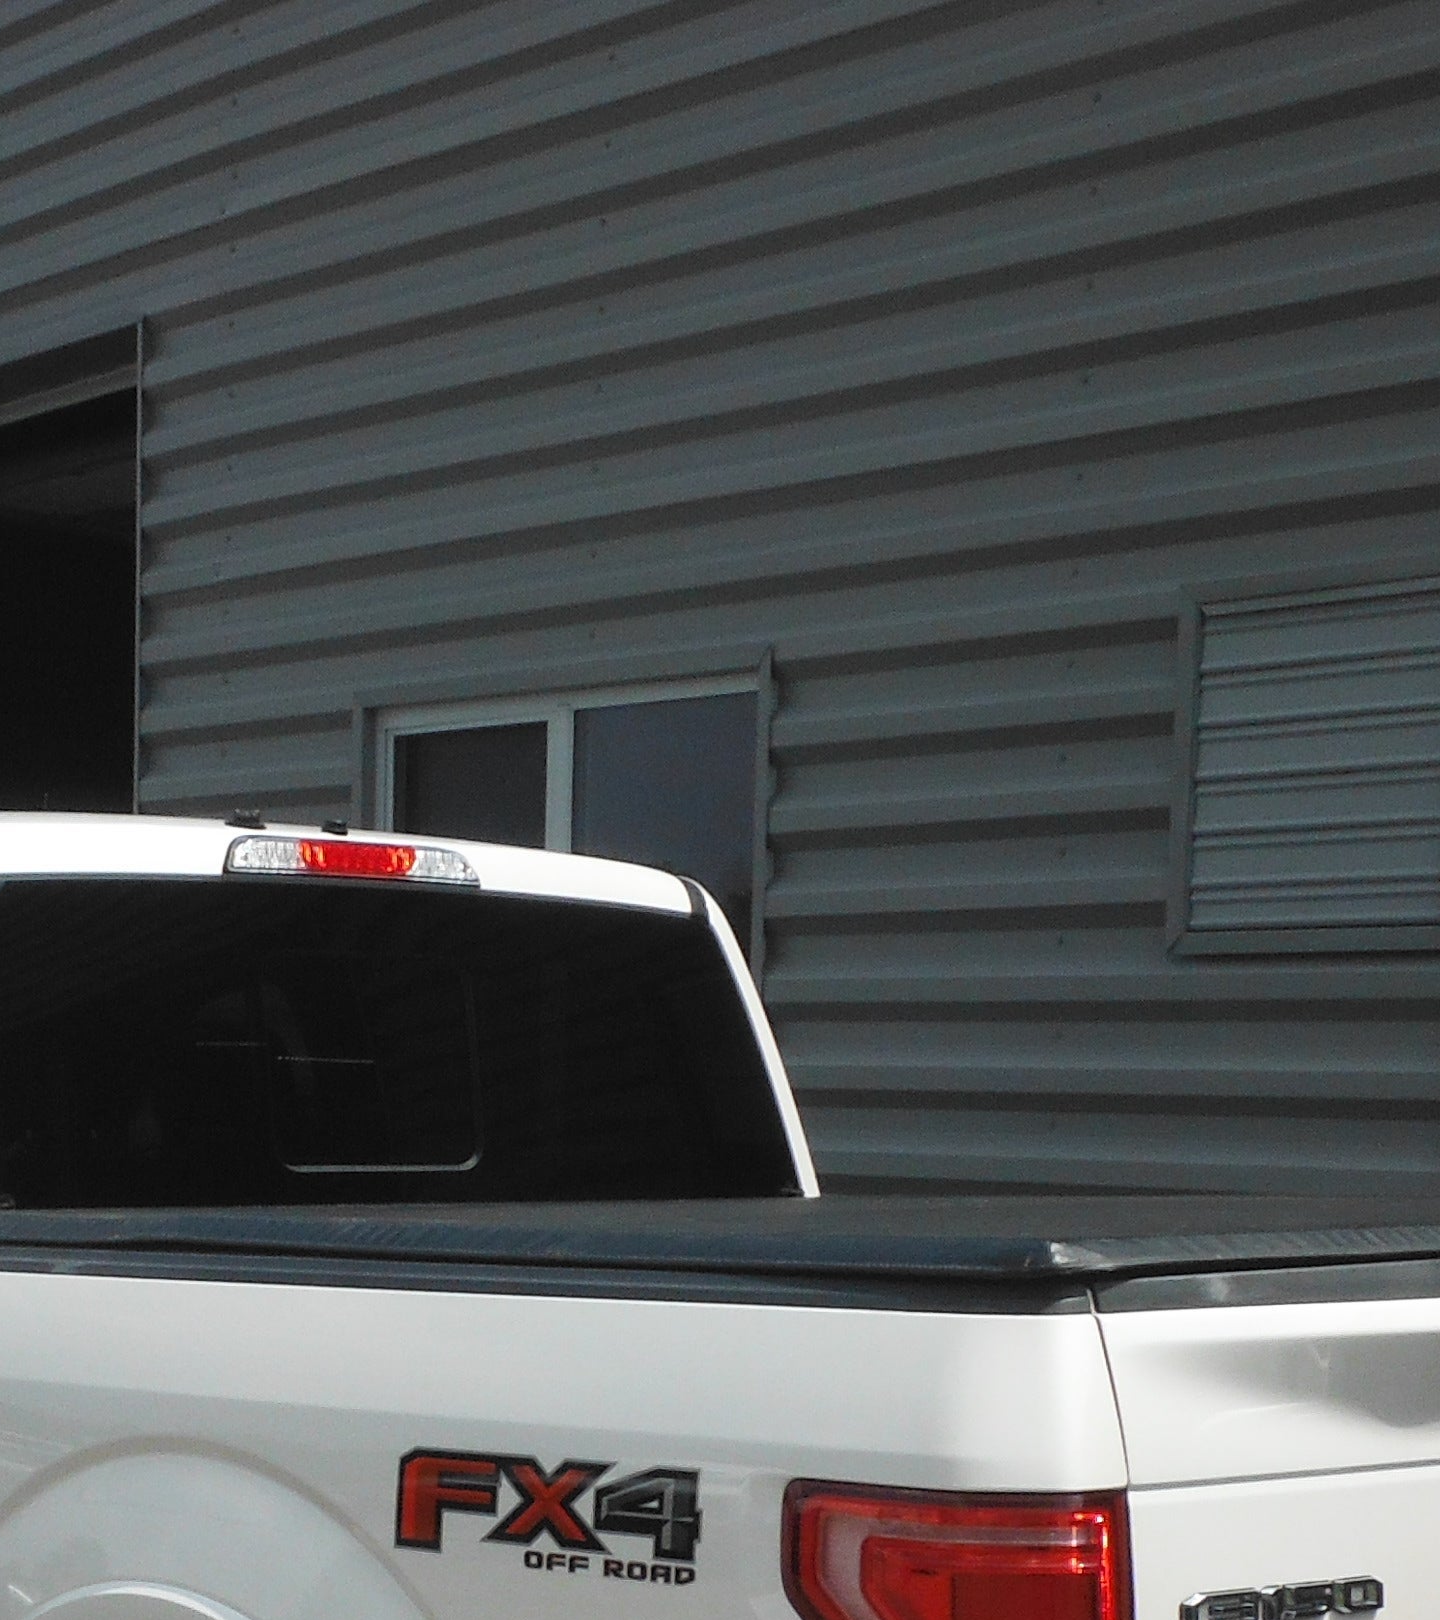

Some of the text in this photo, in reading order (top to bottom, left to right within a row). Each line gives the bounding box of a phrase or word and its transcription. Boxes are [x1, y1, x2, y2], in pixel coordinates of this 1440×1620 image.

[394, 1446, 702, 1562] FX4
[523, 1550, 697, 1586] OFF ROAD
